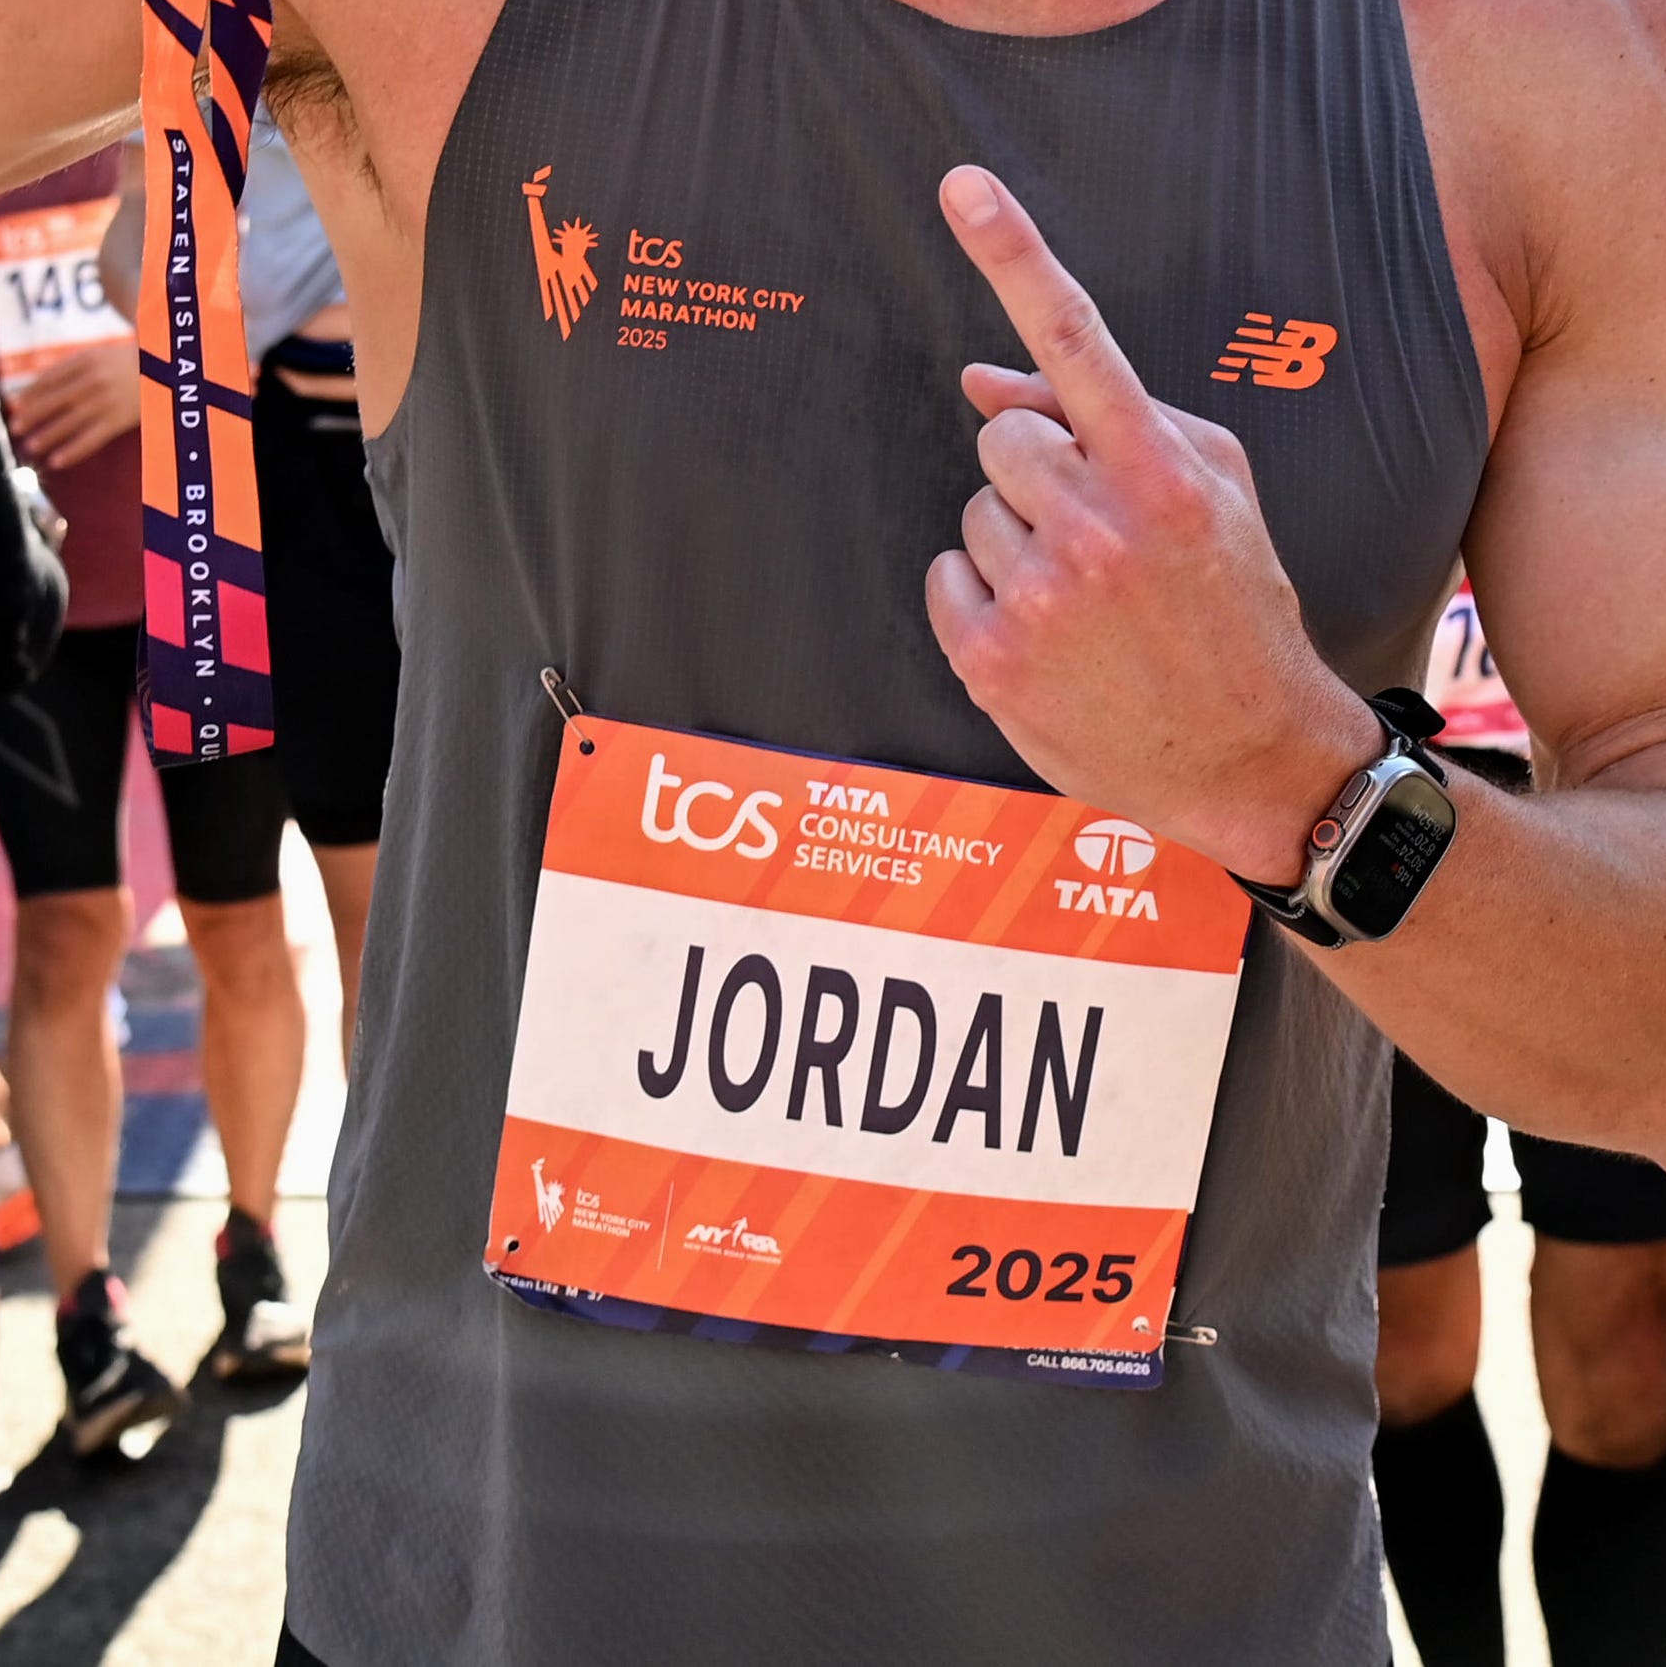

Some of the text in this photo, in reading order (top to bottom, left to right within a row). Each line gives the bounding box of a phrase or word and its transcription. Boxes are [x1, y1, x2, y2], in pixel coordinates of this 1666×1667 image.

[170, 139, 190, 274] STATEN
[627, 229, 683, 269] tcs
[624, 273, 804, 313] NEW YORK CITY
[620, 298, 757, 332] MARATHON
[617, 327, 668, 350] 2025
[174, 296, 202, 429] ISLAND
[185, 484, 216, 678] BROOKLYN
[641, 753, 783, 861] tcs
[805, 780, 890, 818] TATA
[799, 812, 1004, 867] CONSULTANCY
[794, 844, 924, 886] SERVICES
[1053, 878, 1160, 922] TATA
[637, 944, 1105, 1158] JORDAN
[574, 1206, 652, 1231] NEW YORK CITY
[576, 1187, 601, 1209] tcs
[572, 1217, 631, 1238] MARATHON
[946, 1245, 1138, 1304] 2025
[1026, 1353, 1060, 1368] CALL
